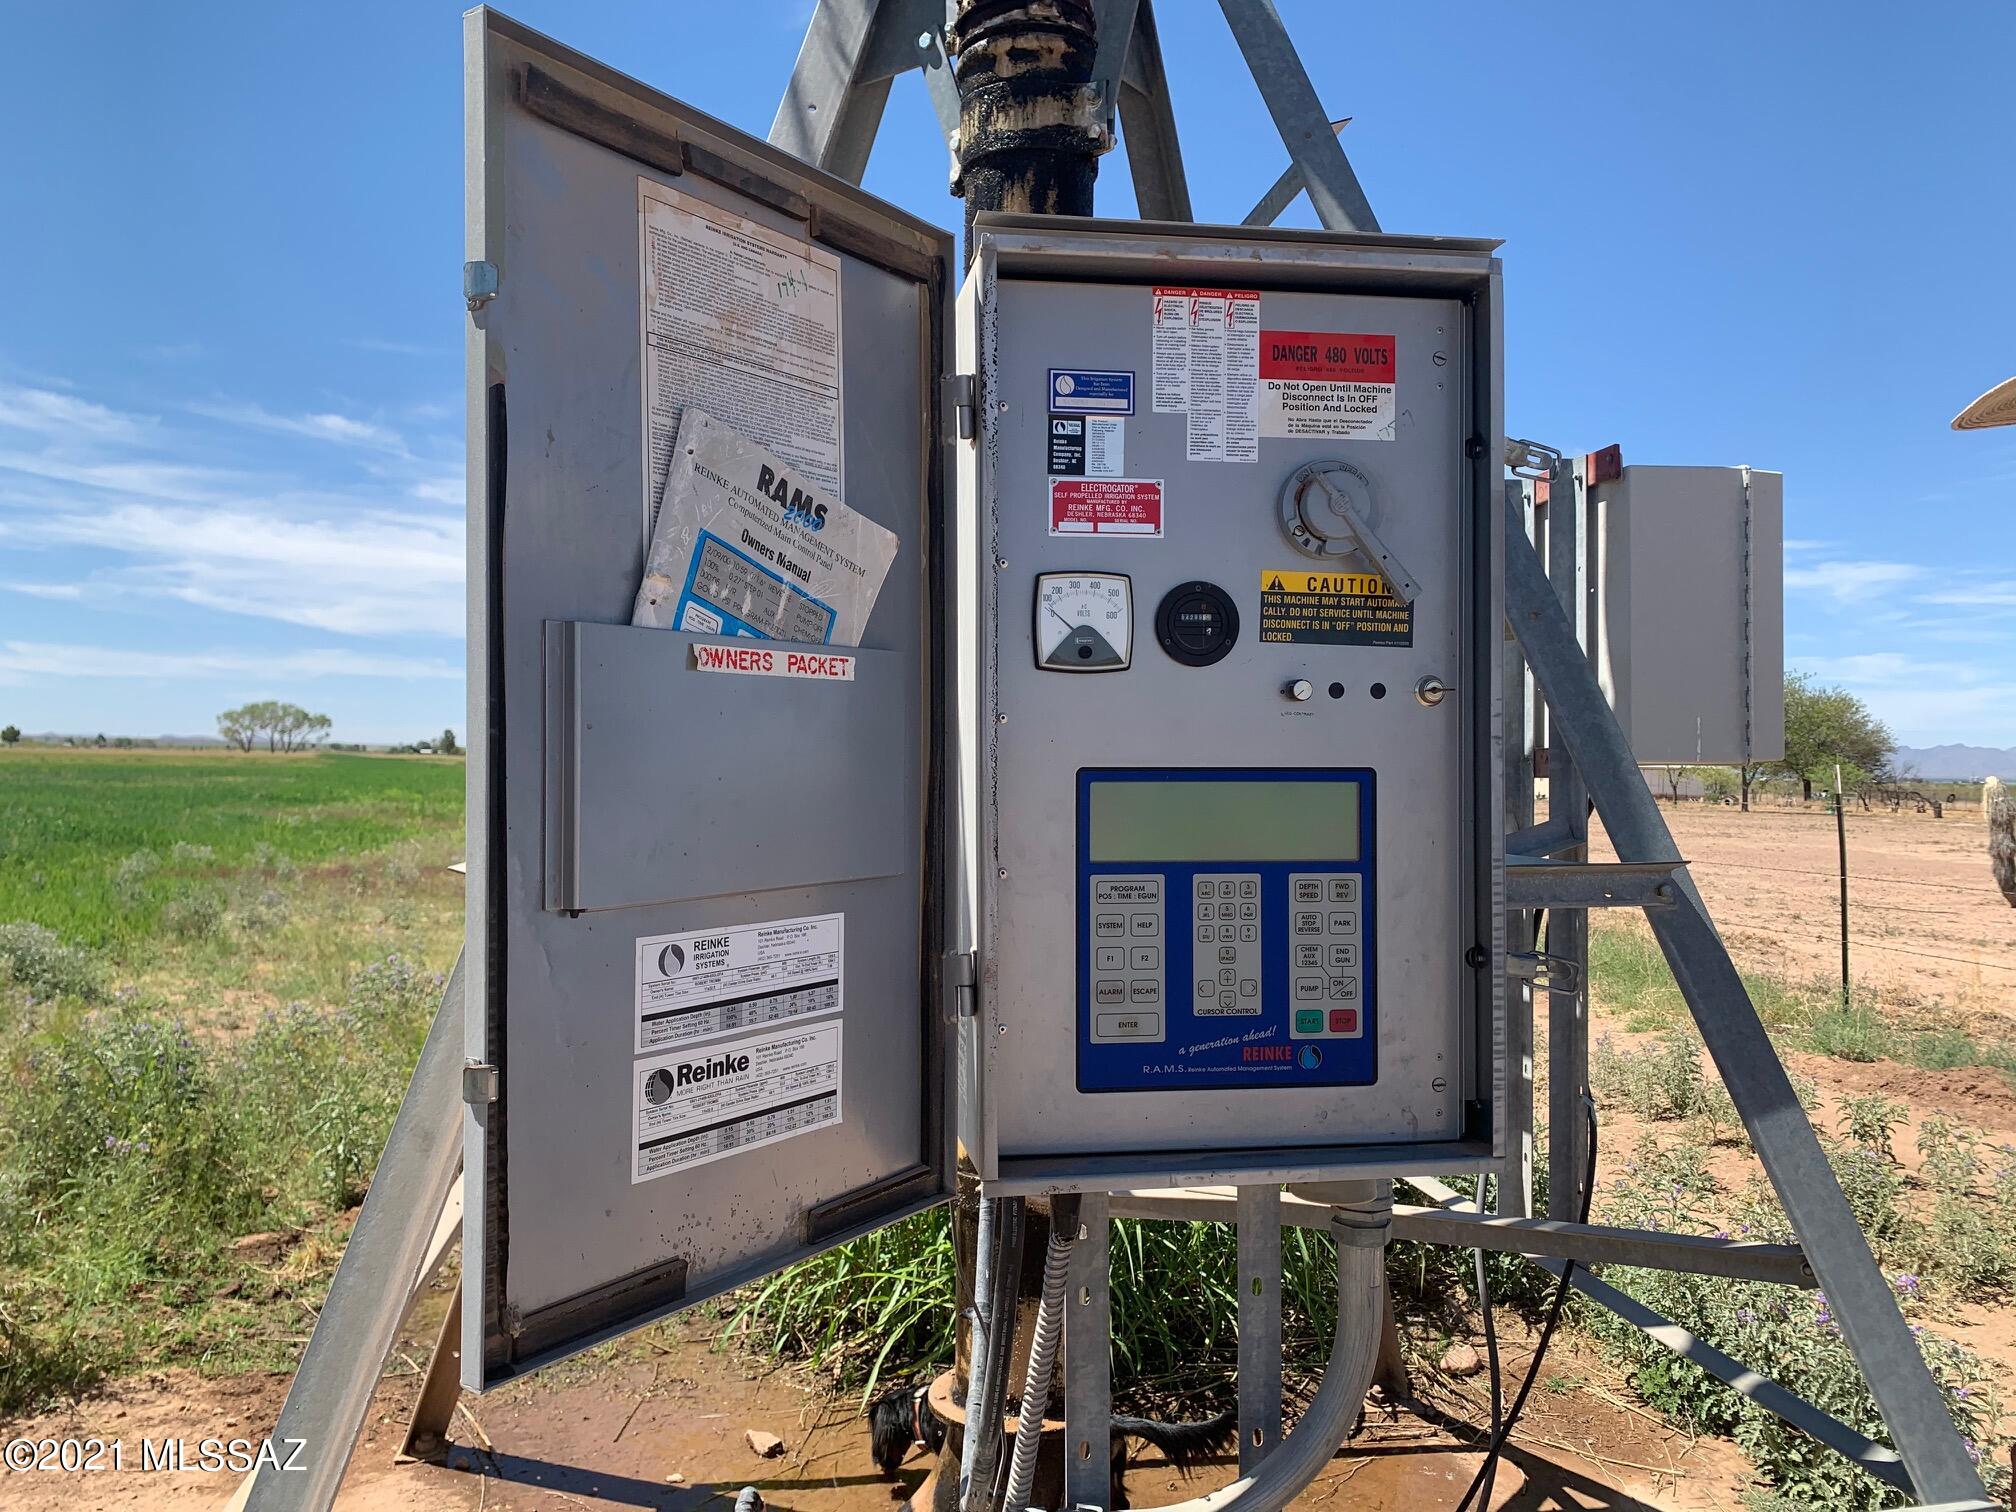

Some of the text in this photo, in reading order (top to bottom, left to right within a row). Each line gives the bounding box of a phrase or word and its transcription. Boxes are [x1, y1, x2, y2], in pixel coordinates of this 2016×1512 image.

[705, 225, 787, 259] REINKE IRRIGATION SYSTEMS WARRANTY
[1272, 345, 1388, 365] DANGER 480 VOLTS
[1268, 381, 1392, 394] Do Not Open Until Machine
[1282, 392, 1378, 404] Disconnect Is In OFF
[1282, 402, 1378, 414] Position And Locked
[756, 463, 829, 531] RAMS
[1096, 504, 1113, 512] MFG.
[694, 462, 729, 490] REINKE
[730, 485, 780, 523] AUTOMATED
[779, 515, 834, 557] MANAGEMENT
[833, 552, 866, 578] SYSTEM
[783, 505, 825, 533] 2000
[728, 497, 833, 572] Computerized Main Control Panel
[741, 527, 812, 584] Owners Manual
[1051, 586, 1062, 595] 200
[1069, 581, 1081, 589] 300
[1090, 581, 1101, 590] 400
[1108, 589, 1120, 597] 500
[1263, 594, 1282, 604] THIS
[1283, 595, 1320, 605] MACHINE
[1321, 596, 1338, 606] MAY
[1340, 597, 1365, 607] START
[1106, 611, 1118, 619] 600
[1263, 607, 1409, 620] CALLY. DO NOT SERVICE UNTIL MACHINE
[1263, 619, 1409, 633] DISCONNECT IS IN "OFF" POSITION AND
[1262, 631, 1295, 642] LOCKED.
[698, 647, 849, 676] OWNERS PACKET
[773, 926, 803, 935] Manufacturing
[693, 936, 730, 952] REINKE
[693, 950, 730, 961] IRRIGATION
[696, 958, 725, 970] SYSTEMS
[665, 1014, 689, 1025] Application
[651, 1022, 697, 1036] Percent Setting
[649, 1029, 692, 1044] Application Duration
[1178, 1024, 1277, 1056] a generation ahead!
[756, 1039, 801, 1054] Reinke Manufacturing
[1243, 1046, 1293, 1061] REINKE
[676, 1054, 750, 1087] Reinke
[1142, 1064, 1187, 1074] R.A.M.S.
[1237, 1065, 1273, 1073] Management
[676, 1074, 750, 1097] MORE RIGHT THAN RAIN
[662, 1140, 687, 1152] Application
[648, 1146, 694, 1163] Percent Setting
[646, 1154, 690, 1172] Application Duration
